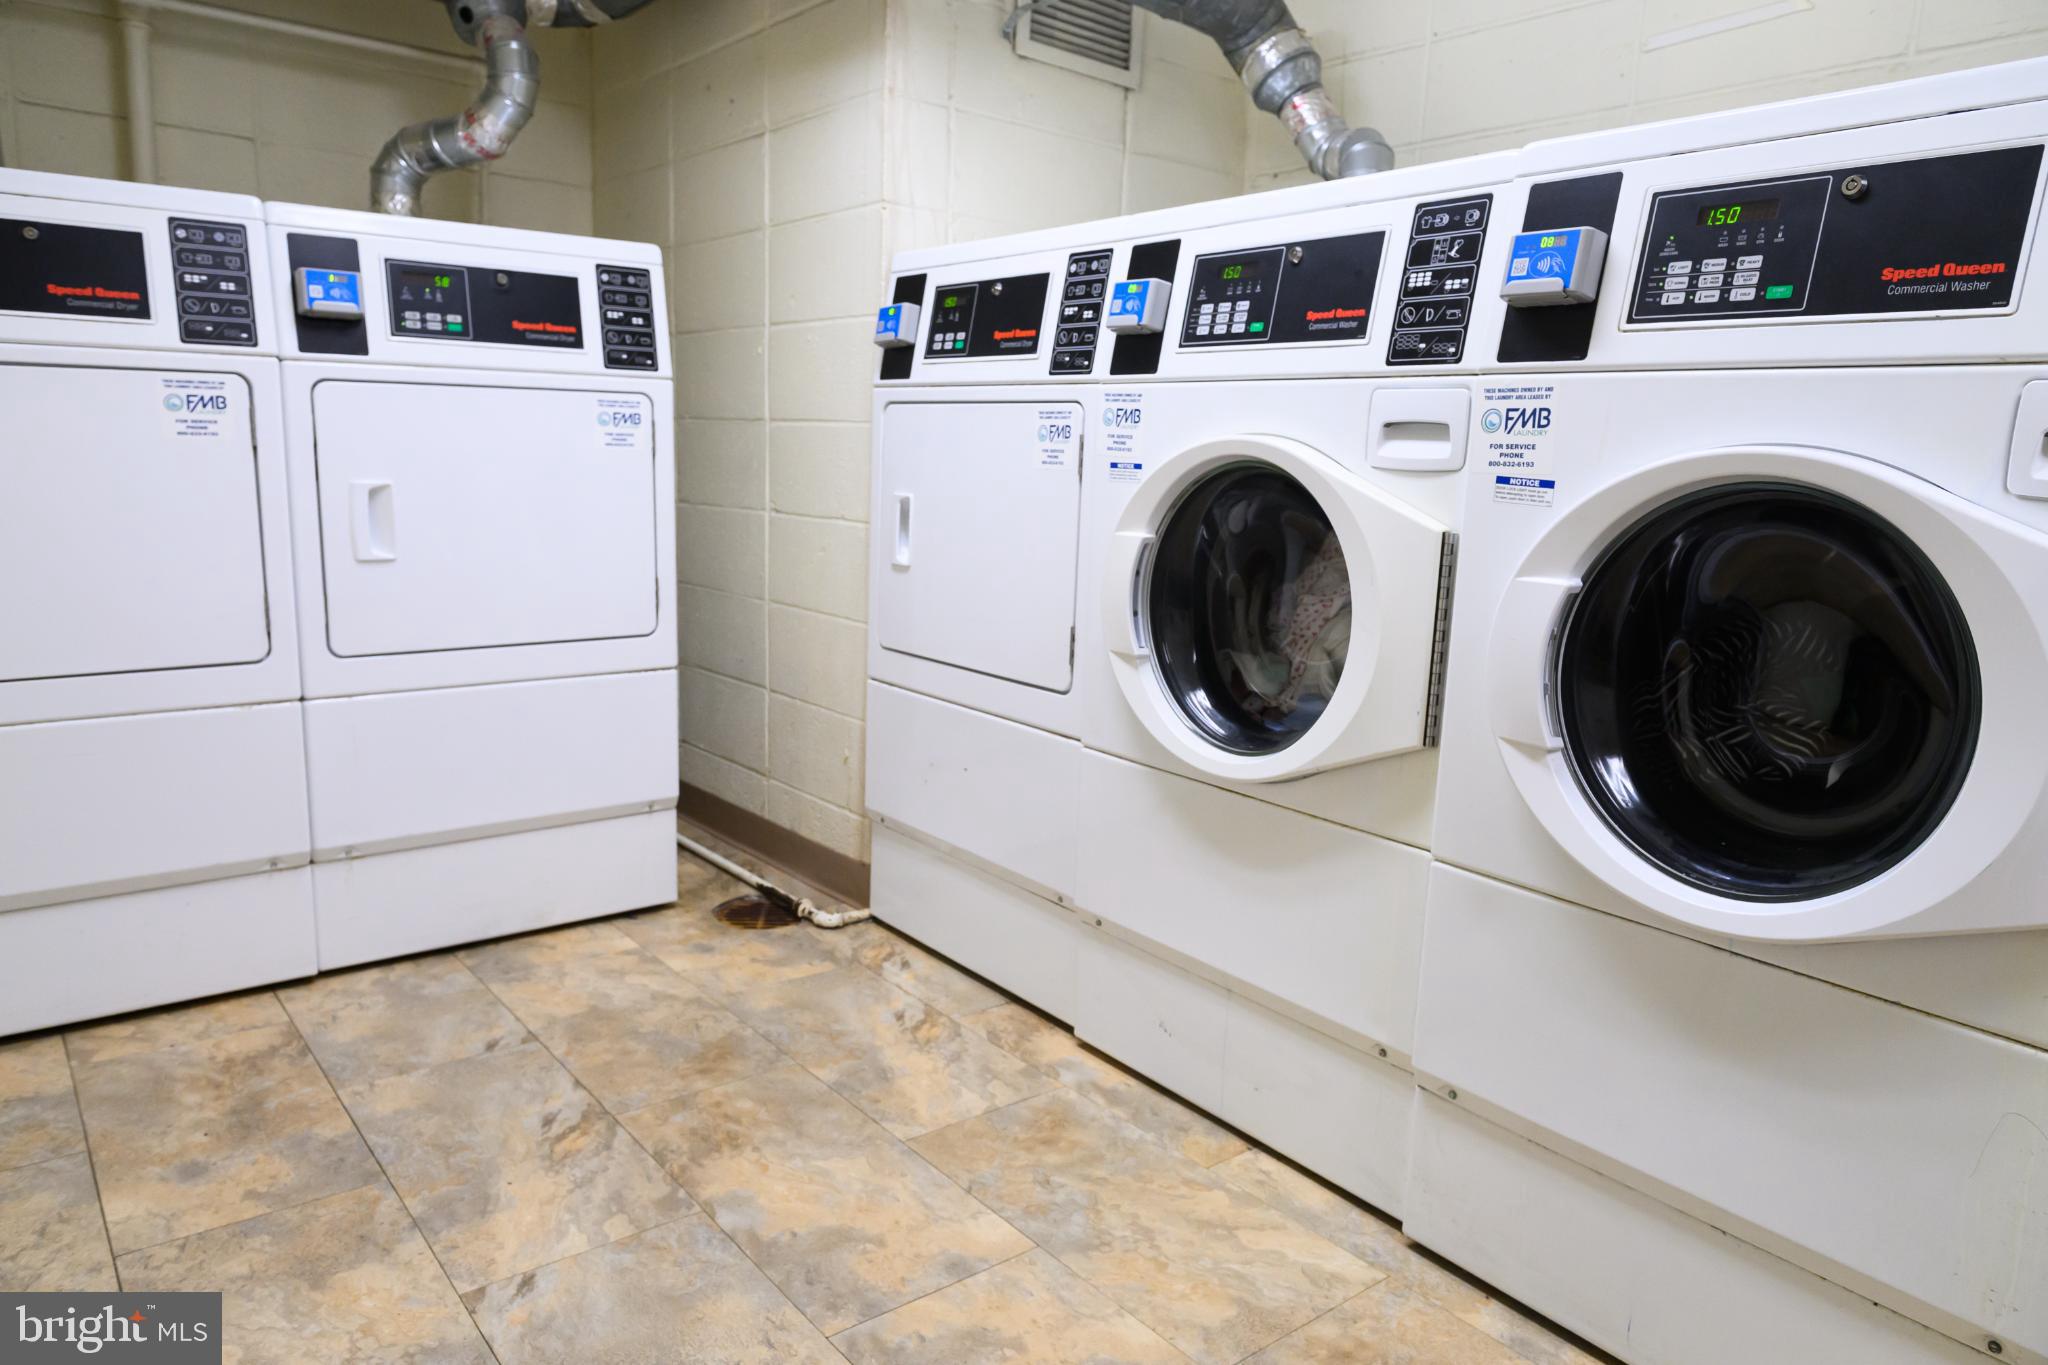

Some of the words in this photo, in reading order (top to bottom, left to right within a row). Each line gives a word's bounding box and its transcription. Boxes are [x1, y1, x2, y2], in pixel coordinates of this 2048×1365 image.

[1881, 264, 1940, 282] Speed
[1943, 262, 2006, 276] Queen
[1887, 282, 1948, 296] Commercial
[1951, 280, 1991, 292] Washer
[1306, 308, 1336, 321] Speed
[1336, 308, 1366, 318] Queen
[186, 394, 227, 413] FMB
[613, 412, 641, 428] FMB
[1116, 408, 1141, 428] FMB
[1504, 407, 1552, 435] FMB
[1049, 424, 1072, 442] FMB
[1509, 477, 1540, 487] NOTICE
